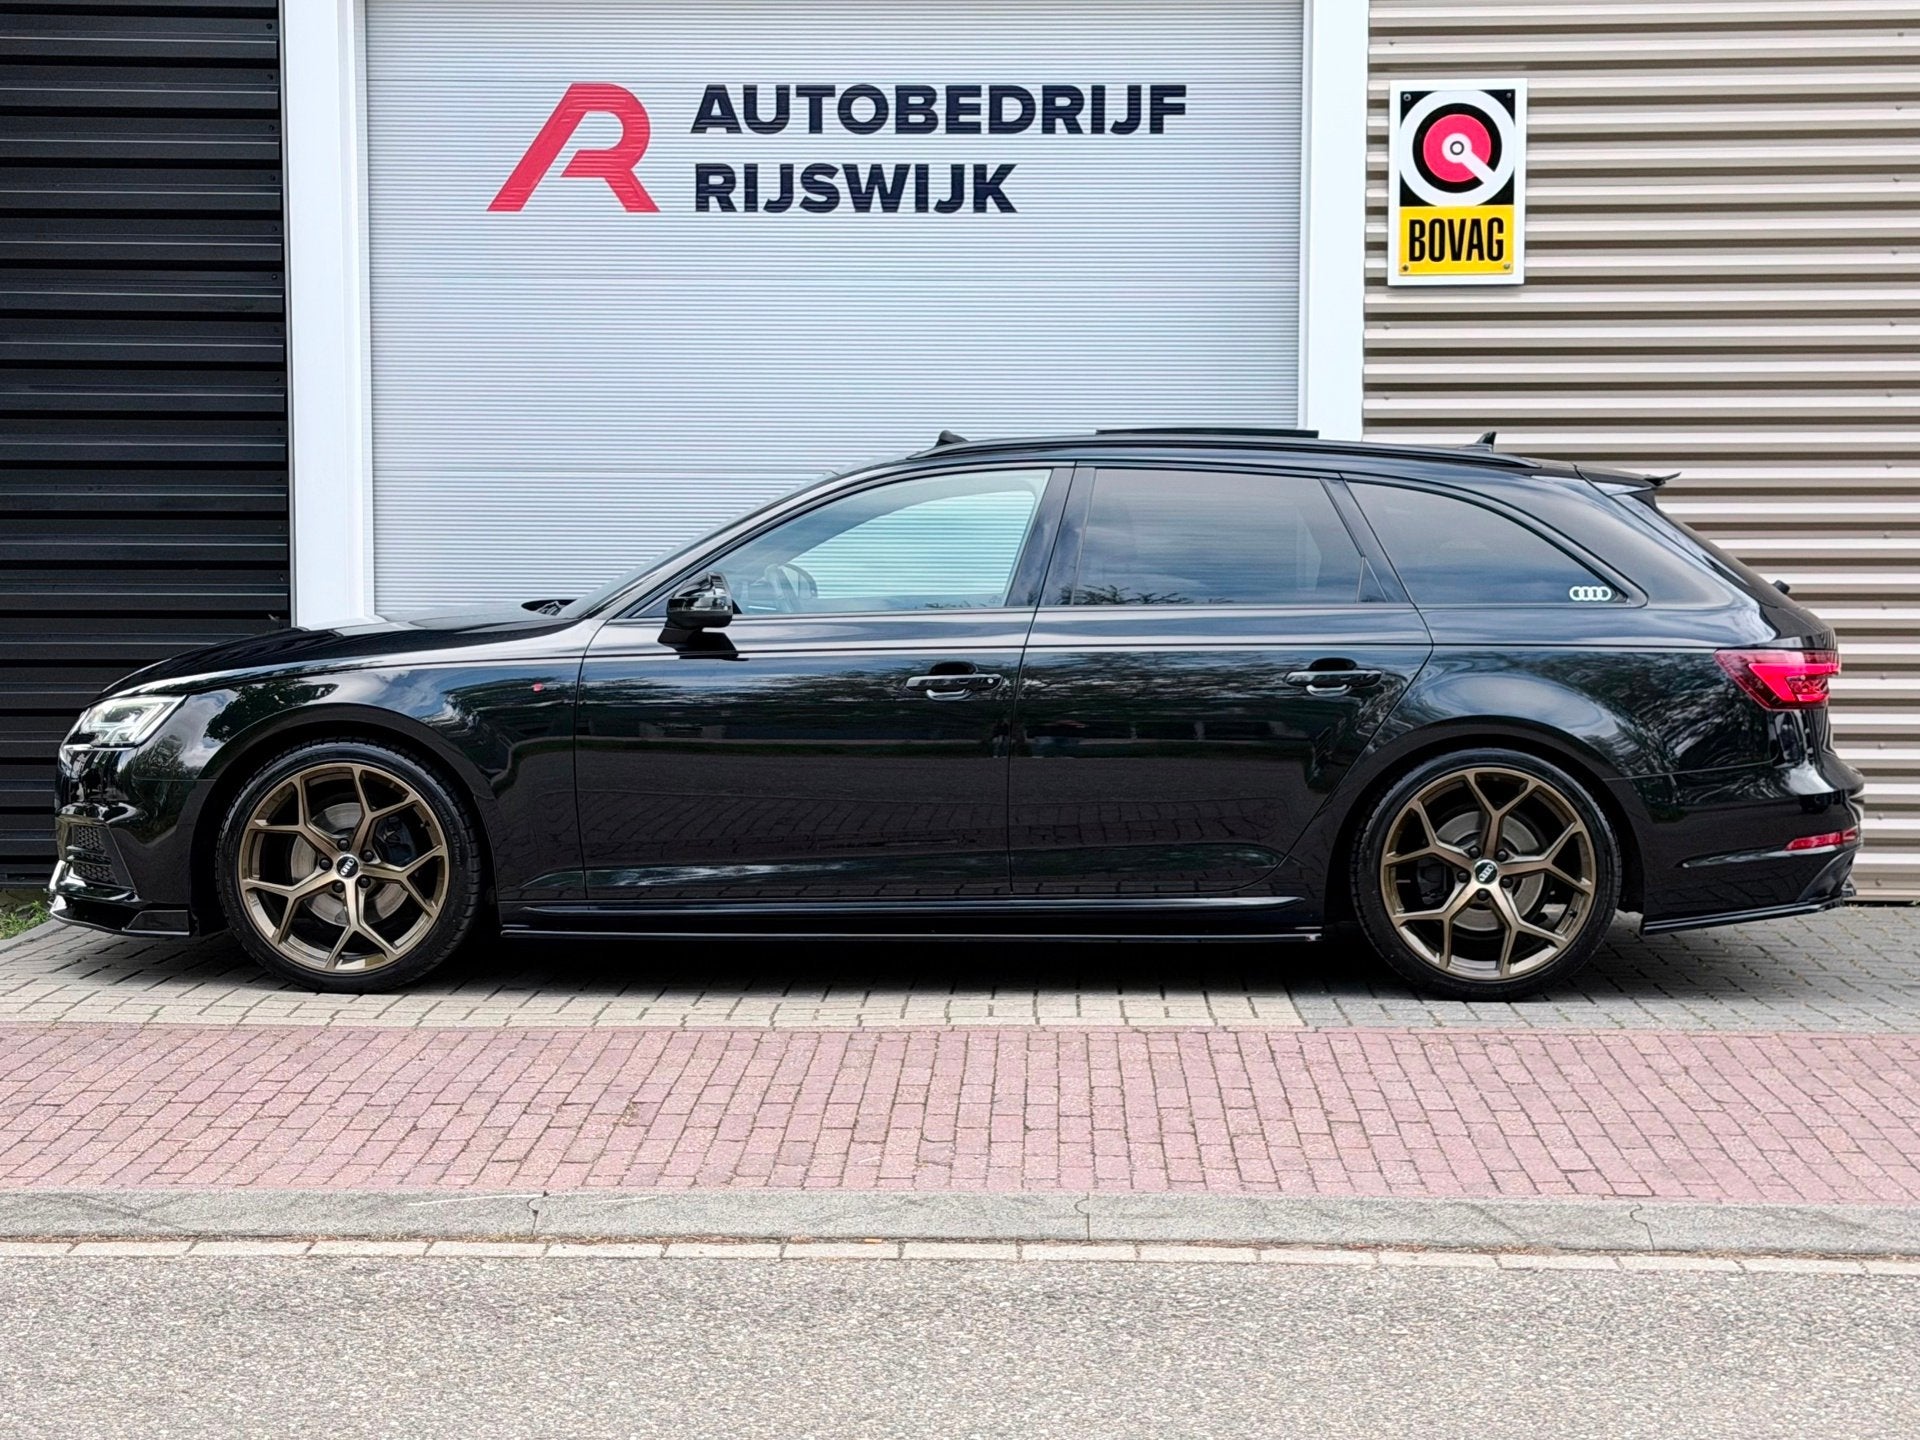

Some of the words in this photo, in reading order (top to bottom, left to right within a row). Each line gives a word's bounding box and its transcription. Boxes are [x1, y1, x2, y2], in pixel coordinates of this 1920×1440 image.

[691, 84, 1187, 135] AUTOBEDRIJF
[695, 163, 1017, 213] RIJSWIJK
[1409, 217, 1504, 262] BOVAG
